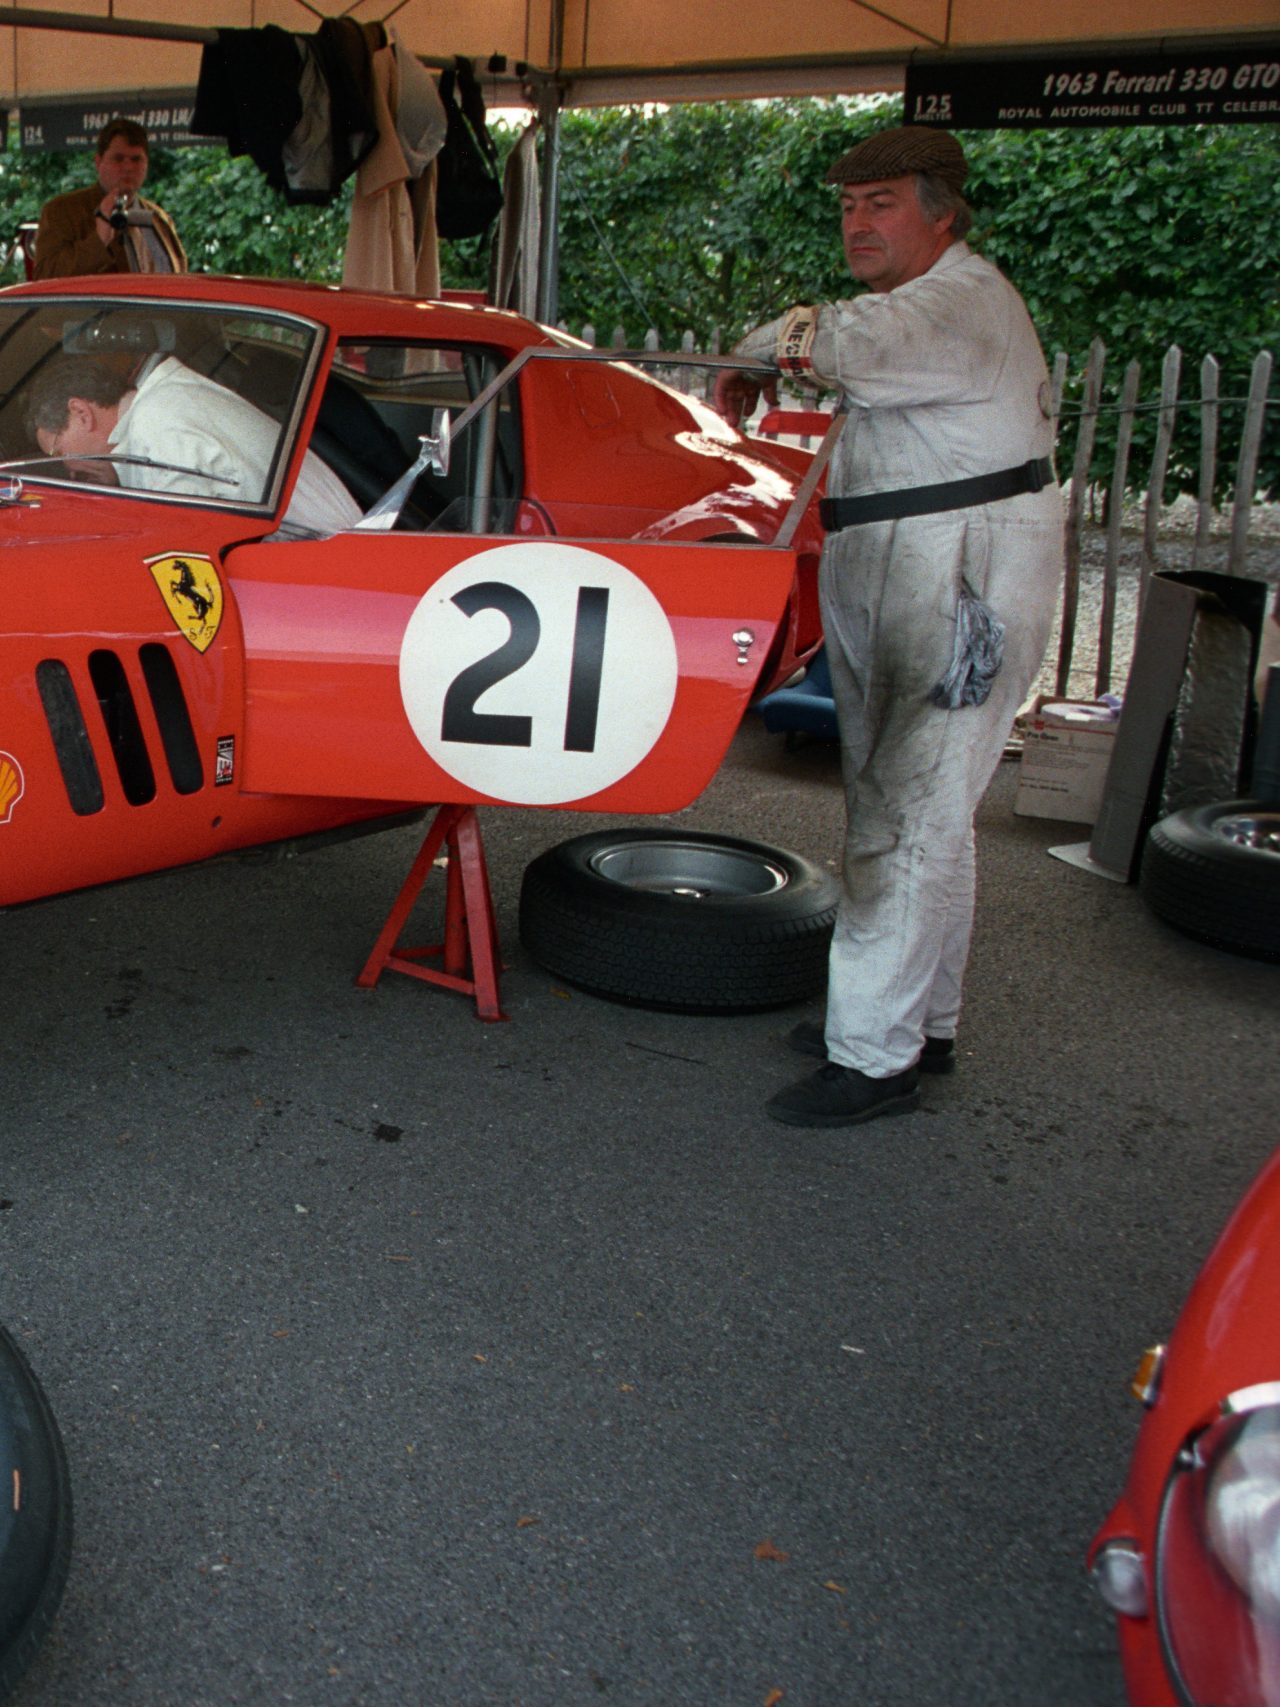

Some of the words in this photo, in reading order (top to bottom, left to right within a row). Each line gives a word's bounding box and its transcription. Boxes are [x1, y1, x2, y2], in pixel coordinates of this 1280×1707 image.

[1043, 72, 1097, 96] 1963
[1103, 68, 1176, 94] Ferrari
[1179, 67, 1228, 91] 330
[1233, 63, 1280, 89] GTO
[915, 95, 951, 114] 125
[998, 108, 1042, 120] ROYAL
[1050, 104, 1140, 118] AUTOMOBILE
[1149, 103, 1186, 115] CLUB
[1196, 102, 1214, 113] TT
[83, 112, 109, 130] 1963
[147, 109, 169, 128] 330
[24, 126, 42, 139] 124
[441, 581, 609, 752] 21
